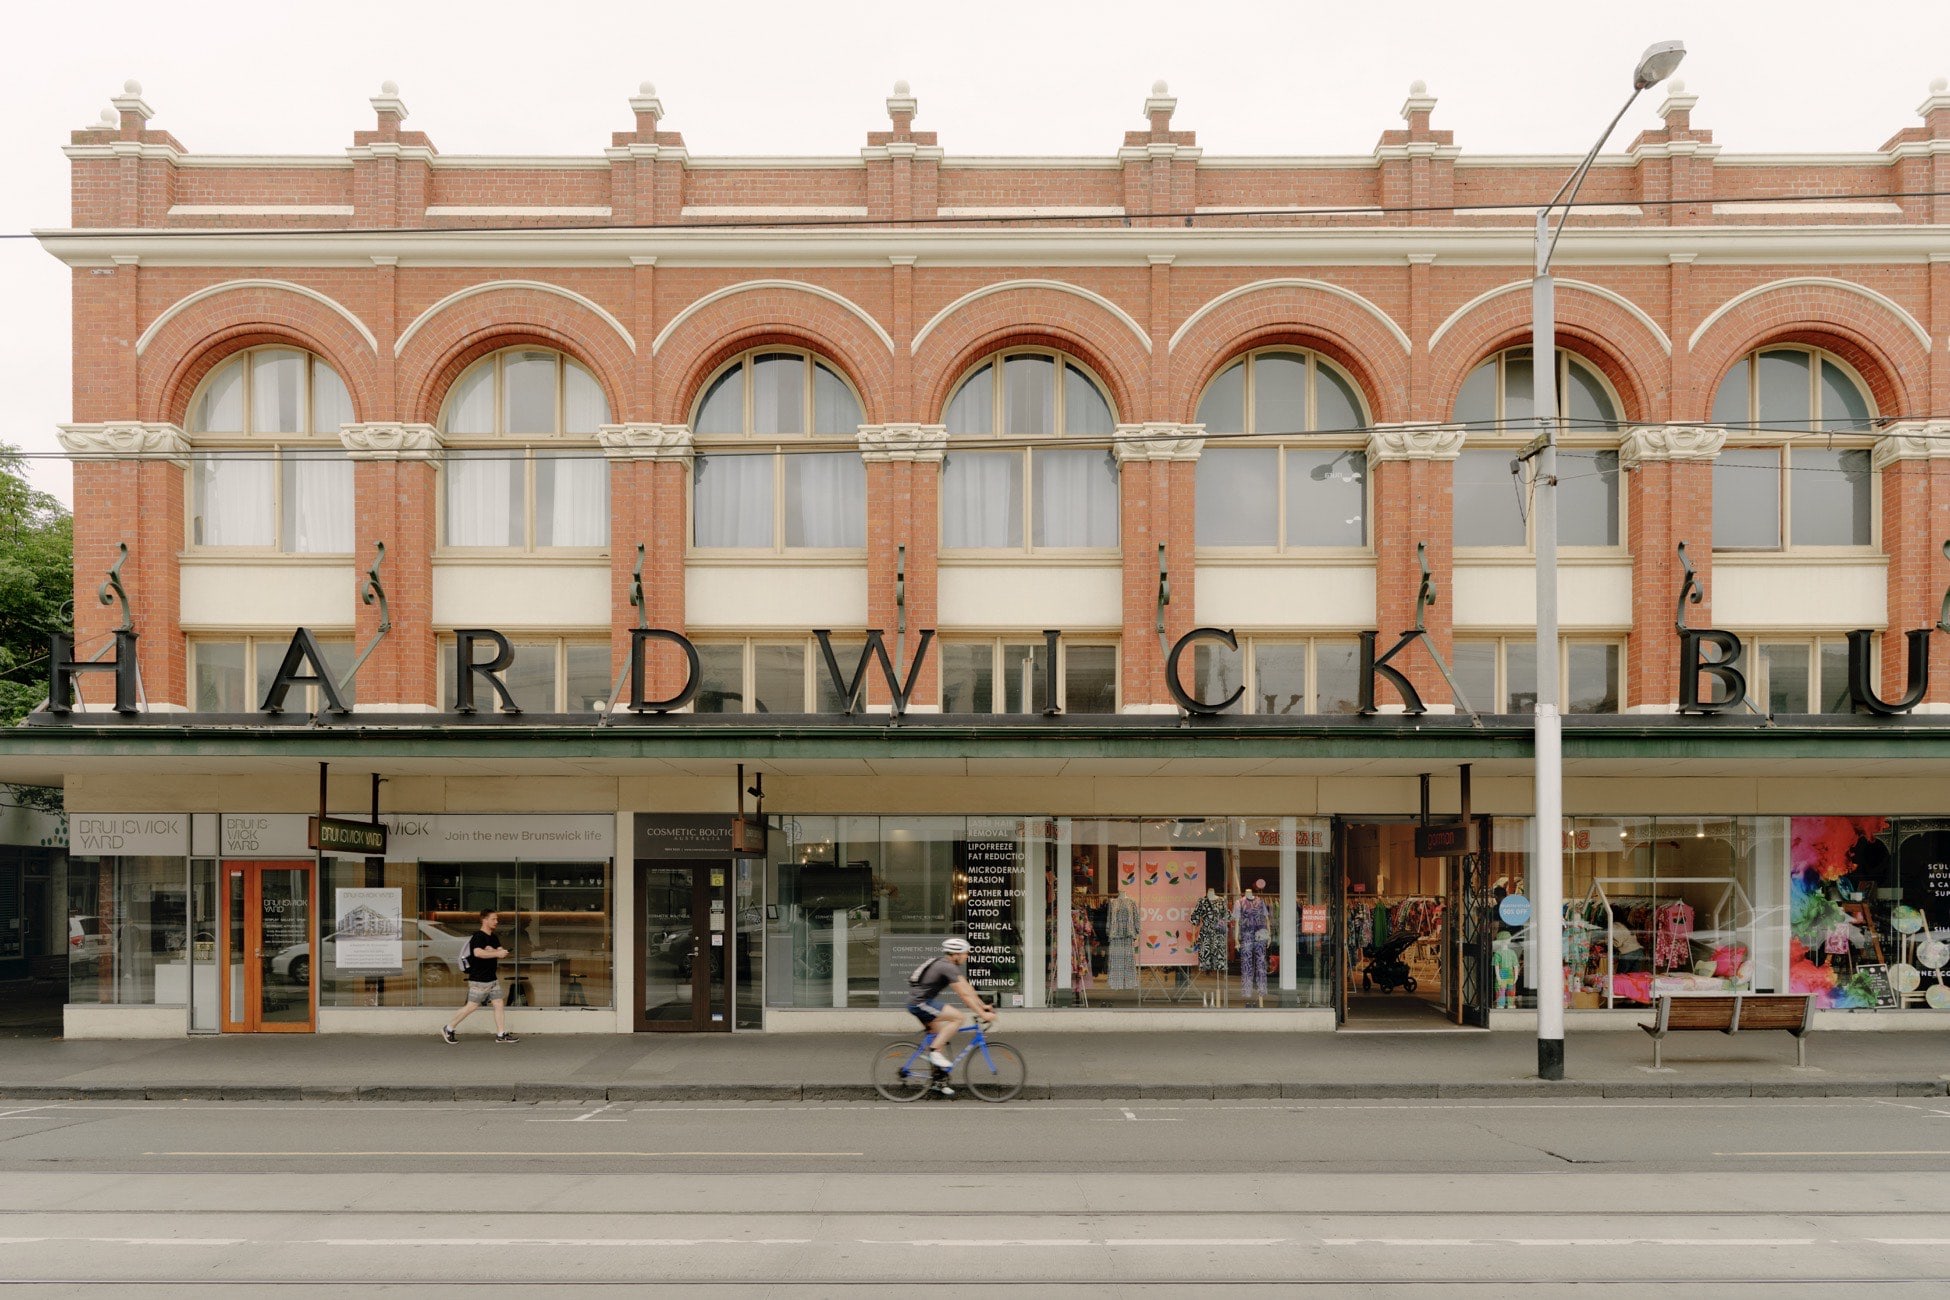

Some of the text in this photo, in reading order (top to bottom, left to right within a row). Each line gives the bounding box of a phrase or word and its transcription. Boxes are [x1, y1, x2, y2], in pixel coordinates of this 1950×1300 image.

[48, 627, 1428, 714] HARDWICK
[79, 820, 178, 834] BRUNSWICK
[227, 819, 268, 829] BRUNS
[227, 830, 258, 840] WICK
[321, 826, 383, 847] BRUNSWICK YARD
[445, 830, 602, 841] Join the new Brunswick life
[646, 828, 696, 837] COSMETIC
[968, 829, 1009, 837] REMOVAL
[80, 835, 124, 849] YARD
[227, 840, 260, 850] YARD
[968, 842, 1013, 851] LIPOFREEZE
[968, 852, 983, 861] FAT
[968, 866, 1026, 874] MICRODERMA
[968, 876, 1005, 884] BRASION
[968, 889, 1002, 897] FEATHER
[968, 899, 1011, 907] COSMETIC
[968, 909, 1000, 917] TATTOO
[1140, 907, 1196, 922] 0% OF
[968, 922, 1012, 930] CHEMICAL
[968, 932, 990, 940] PEELS
[968, 946, 1011, 954] COSMETIC
[968, 955, 1016, 963] INJECTIONS
[968, 979, 1015, 987] WHITENING
